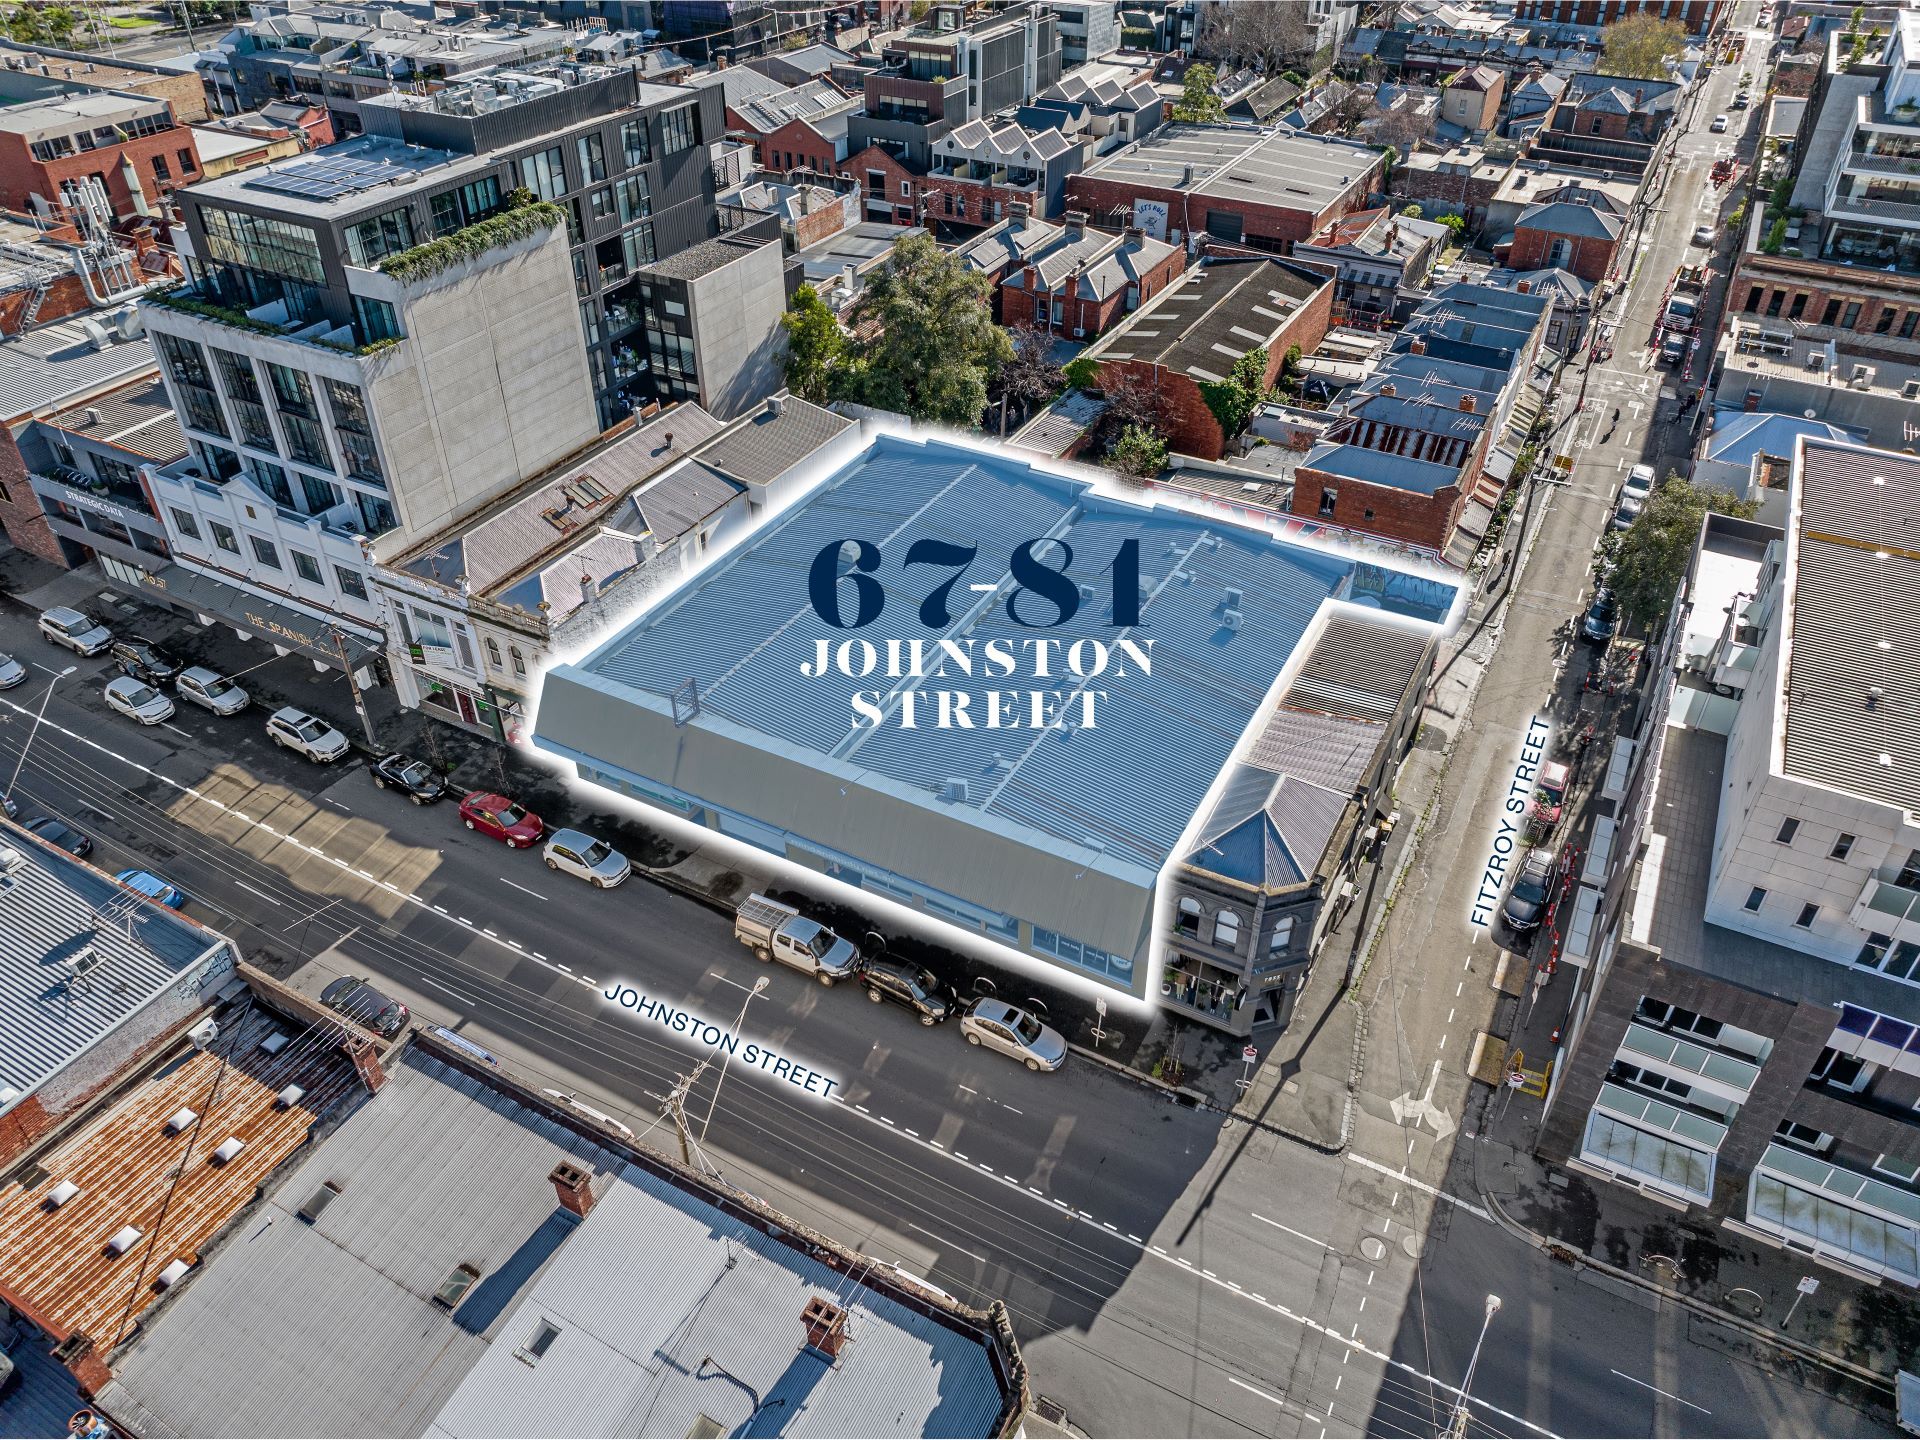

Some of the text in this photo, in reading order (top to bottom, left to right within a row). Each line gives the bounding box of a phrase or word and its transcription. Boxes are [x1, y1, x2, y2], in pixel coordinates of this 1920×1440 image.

[1153, 205, 1166, 217] ROLL
[65, 490, 124, 518] STRATEGIC DATA
[245, 612, 264, 628] THE
[264, 621, 313, 647] SPANISH
